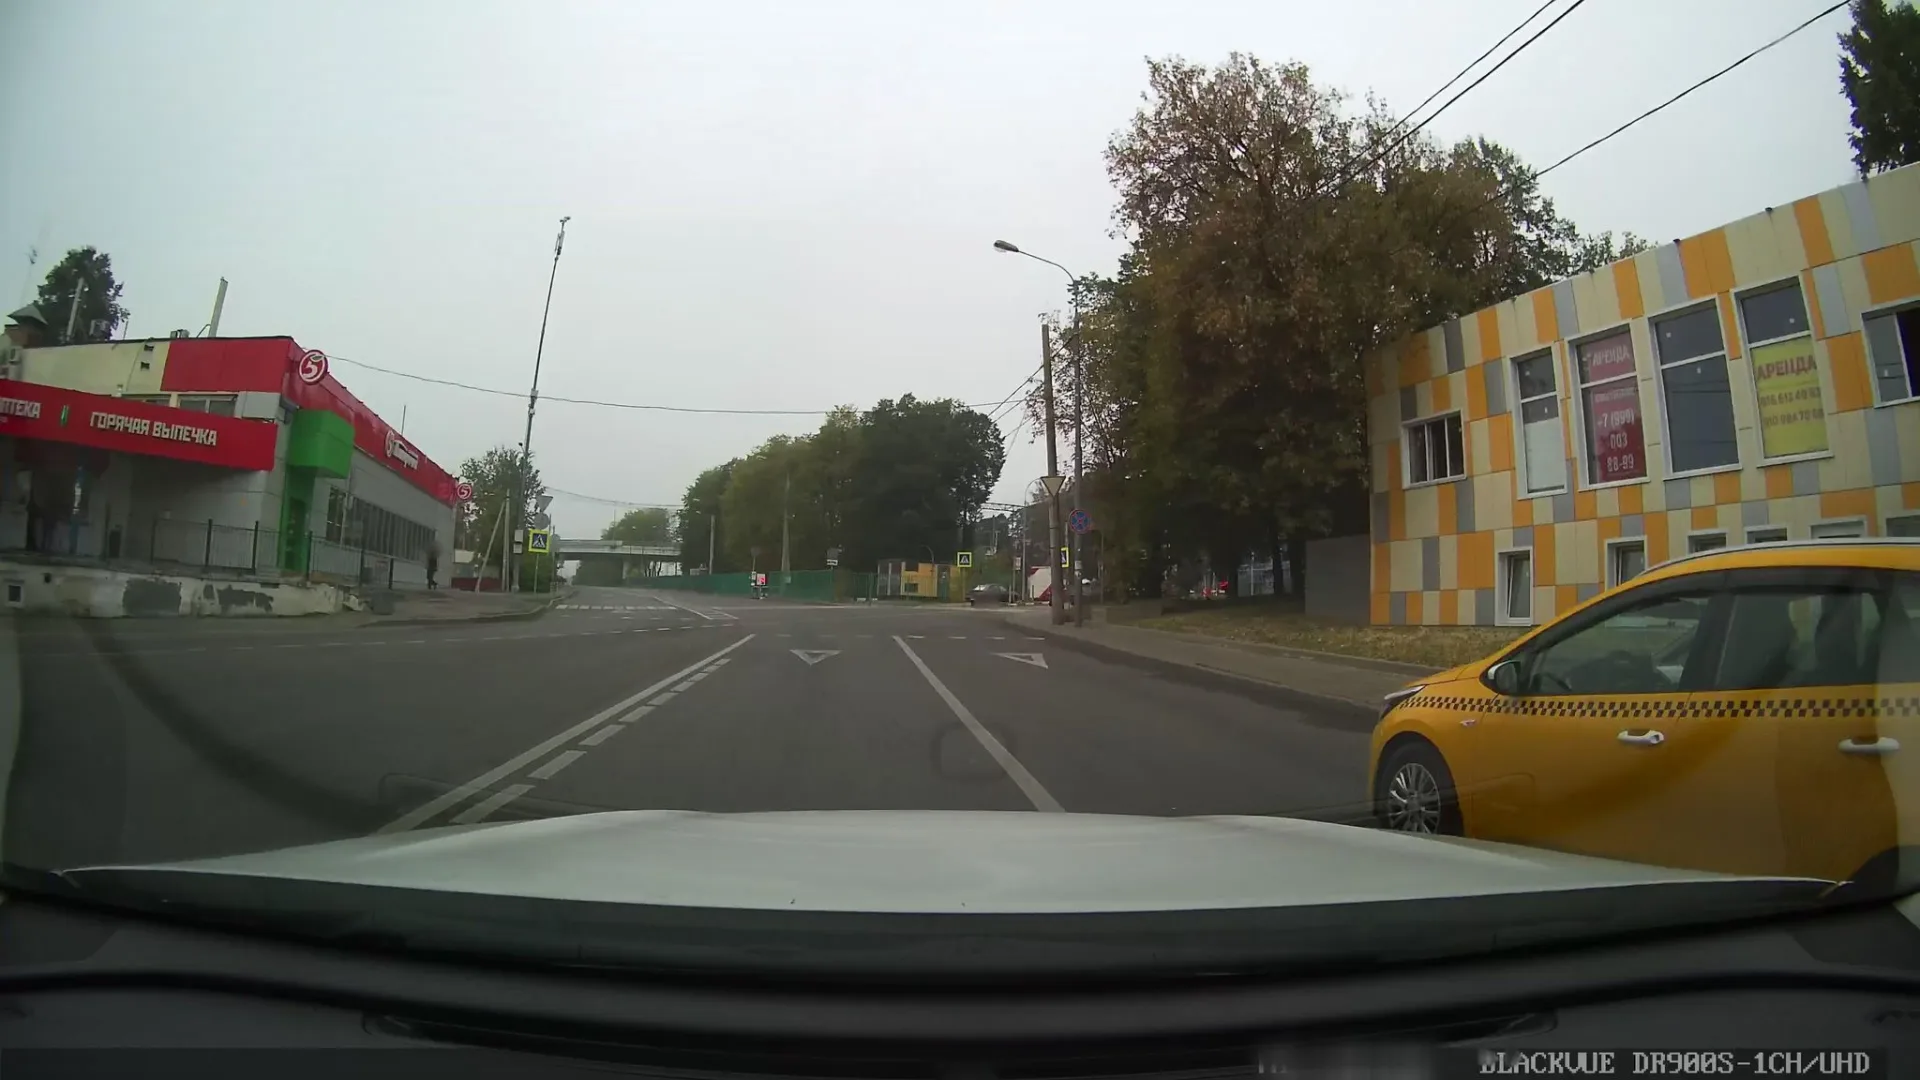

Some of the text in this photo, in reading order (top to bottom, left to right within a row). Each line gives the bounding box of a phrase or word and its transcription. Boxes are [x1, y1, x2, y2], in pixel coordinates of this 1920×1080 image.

[1757, 354, 1817, 380] АРЕНДА
[0, 397, 41, 418] ПТЕКА
[90, 411, 217, 446] ГОРЯЧАЯ ВЫПЕЧКА
